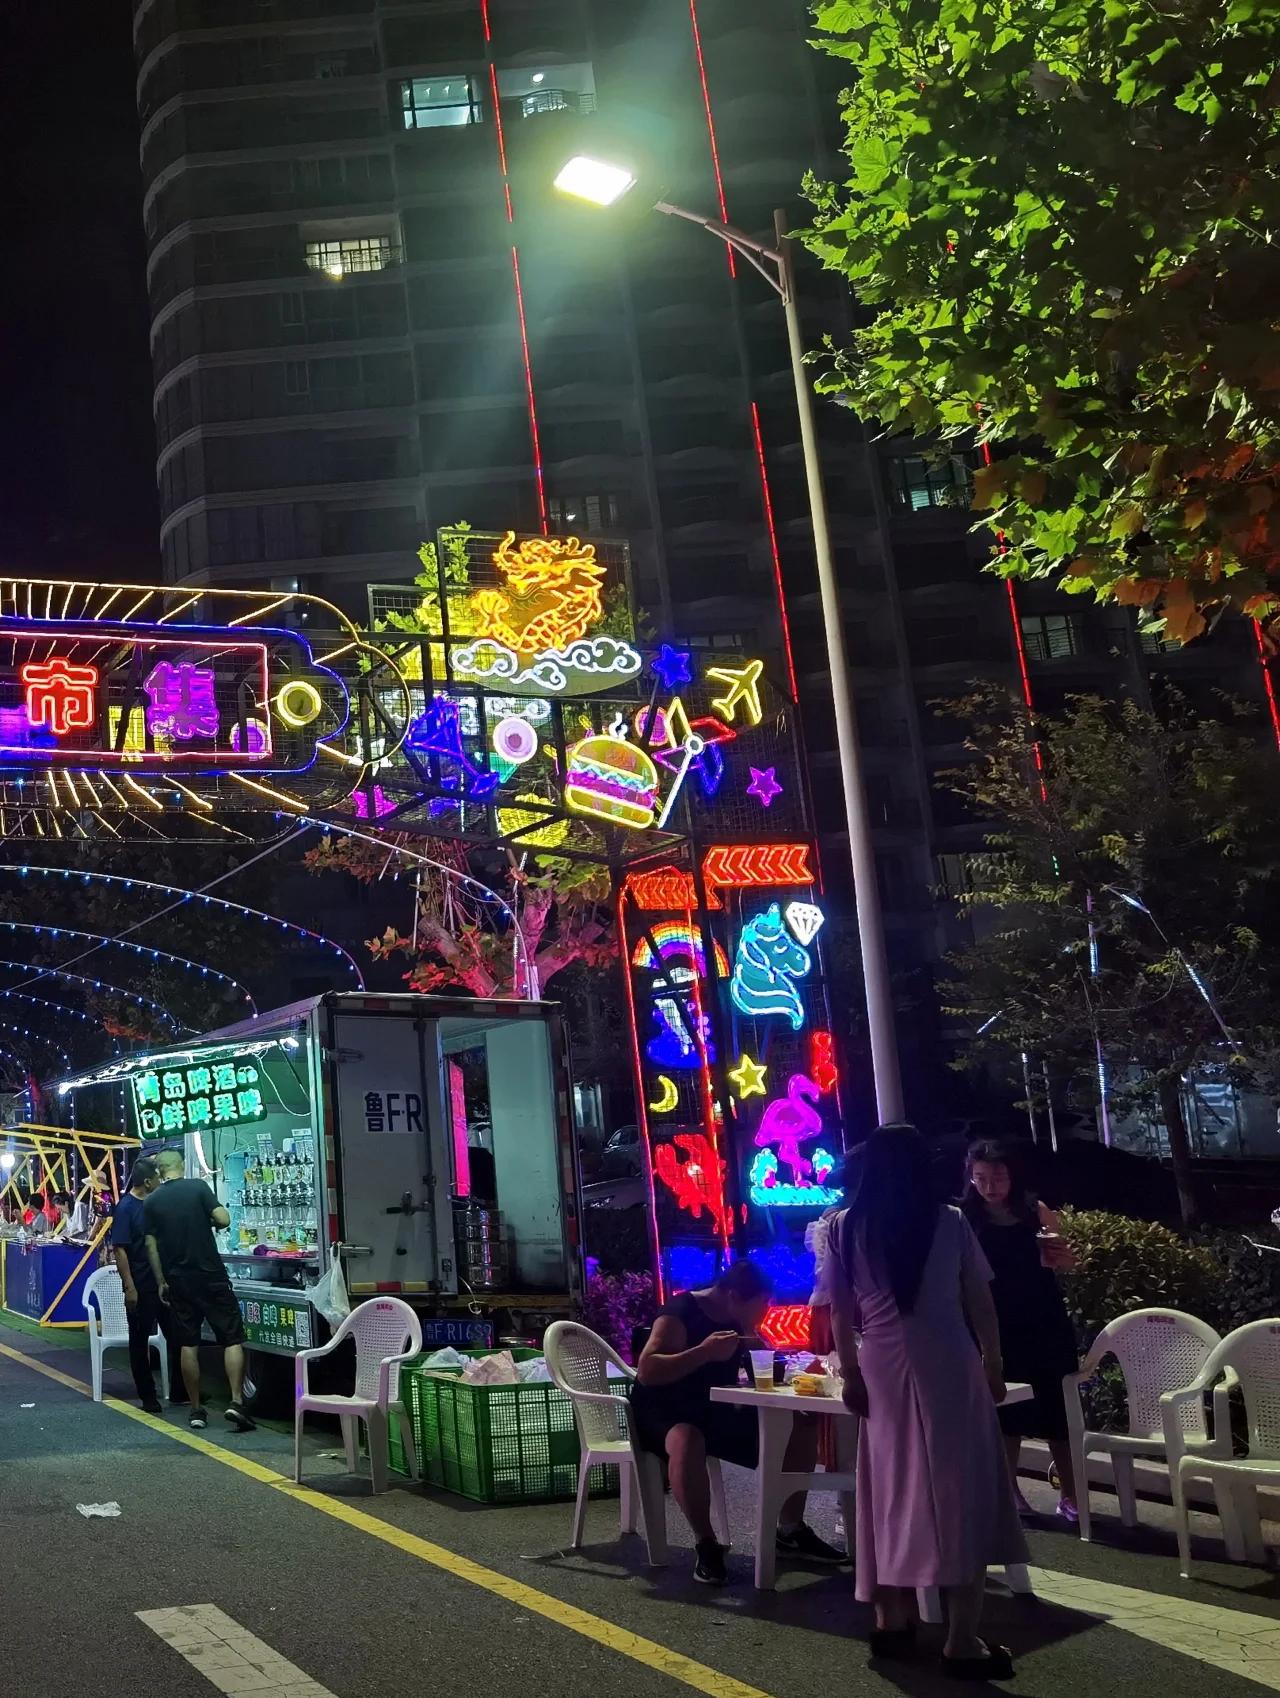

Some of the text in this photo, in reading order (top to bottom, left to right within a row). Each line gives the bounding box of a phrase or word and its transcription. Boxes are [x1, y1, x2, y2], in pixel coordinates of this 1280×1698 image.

[136, 1063, 238, 1105] 青岛啤酒
[161, 1088, 264, 1130] 鲜啤果啤
